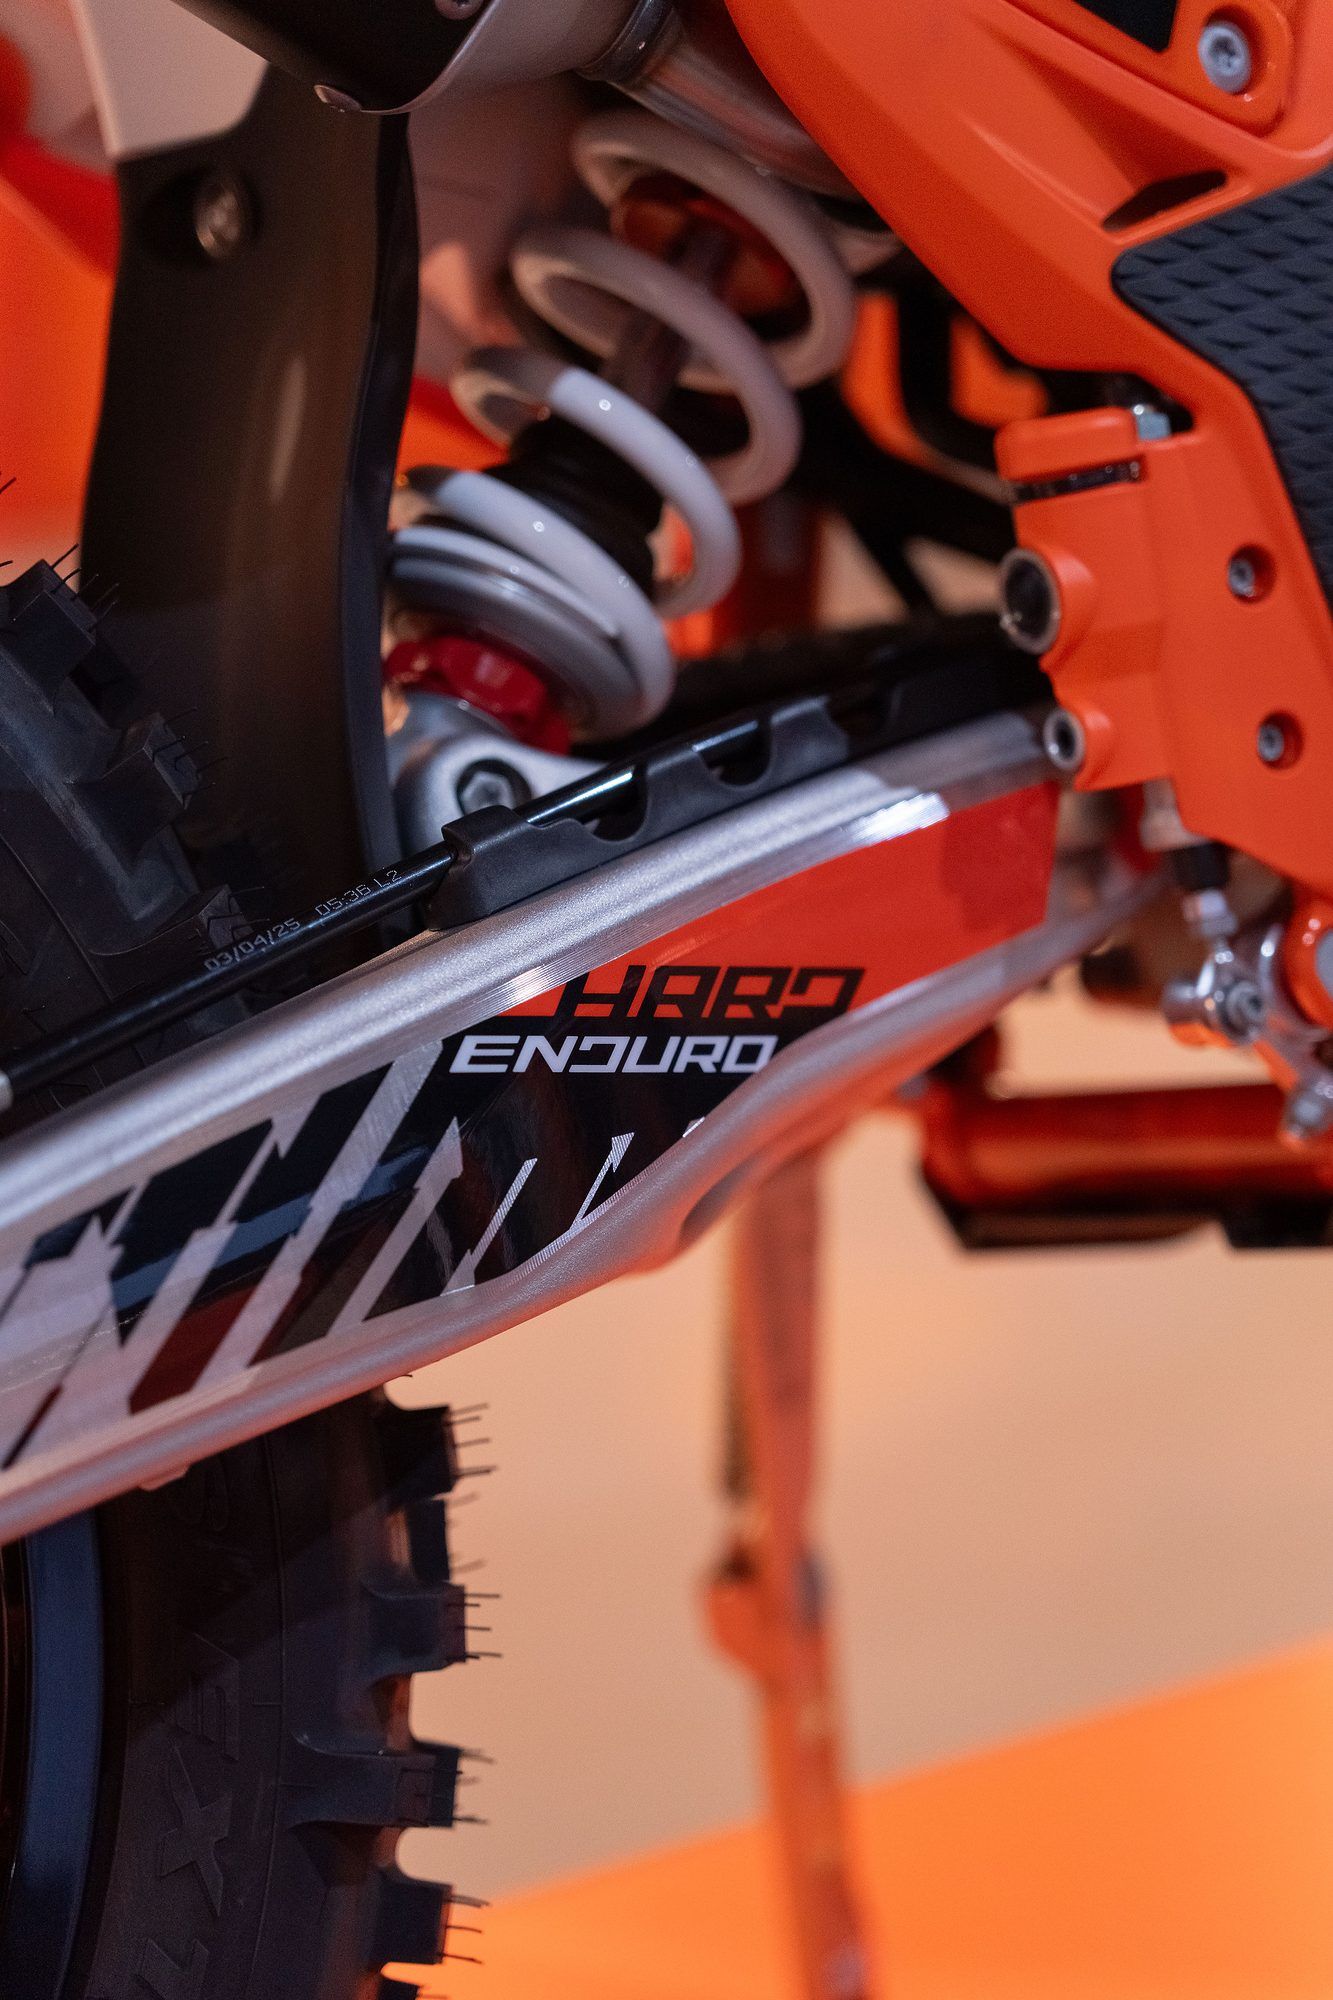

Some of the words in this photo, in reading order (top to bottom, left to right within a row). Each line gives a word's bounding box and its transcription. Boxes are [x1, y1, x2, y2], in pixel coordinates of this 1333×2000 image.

[204, 918, 300, 970] 03/04/25
[315, 884, 371, 916] 05:36
[373, 869, 402, 888] L2
[555, 965, 864, 1019] HARD
[449, 1035, 779, 1073] ENDURO
